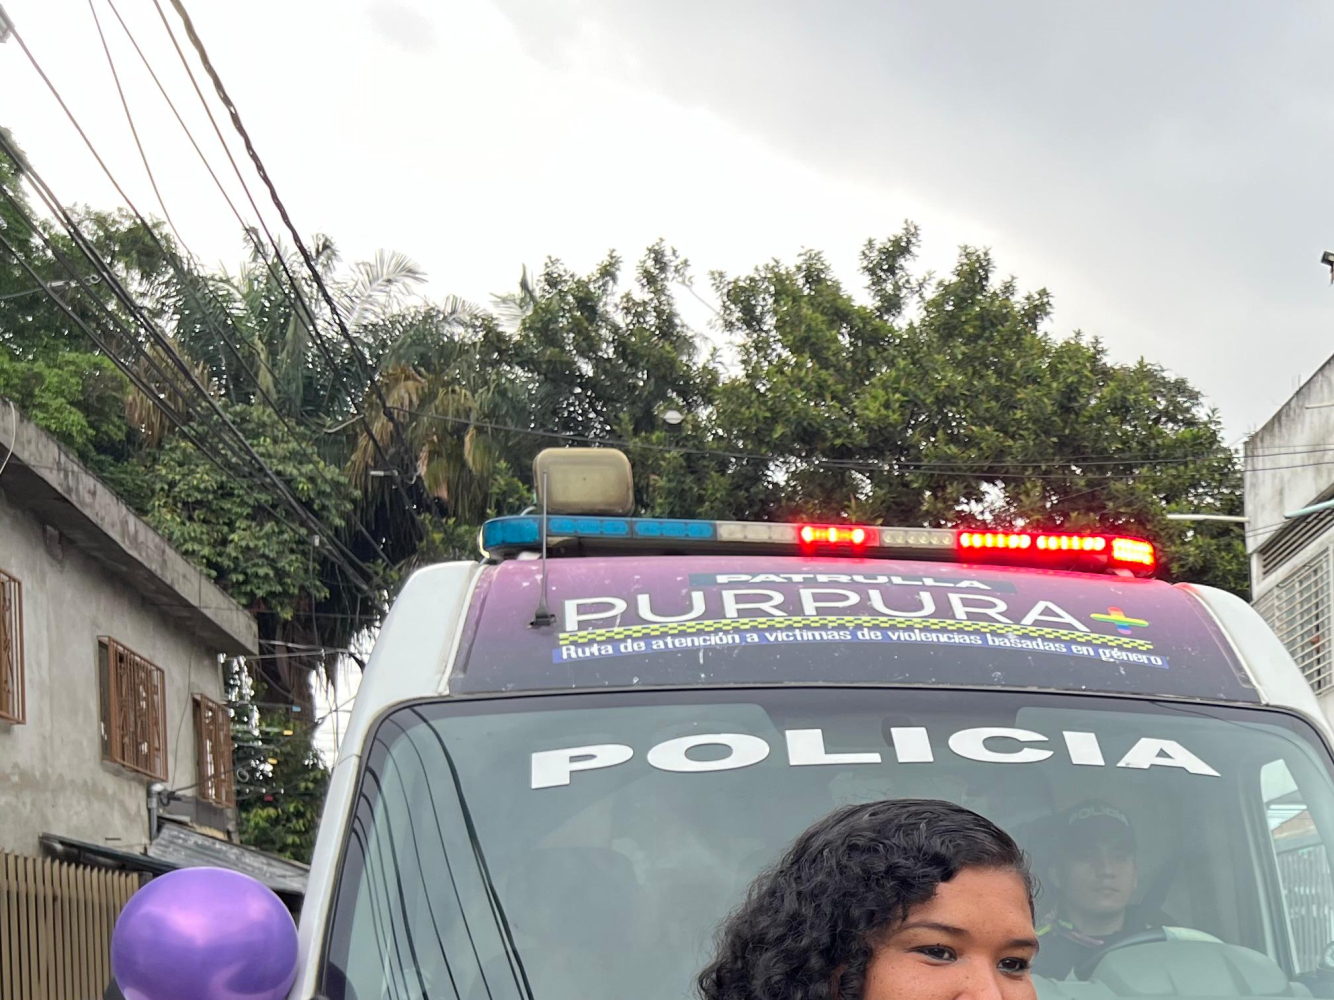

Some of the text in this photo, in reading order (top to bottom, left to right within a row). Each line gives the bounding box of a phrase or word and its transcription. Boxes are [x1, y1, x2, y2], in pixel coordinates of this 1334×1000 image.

[716, 573, 992, 590] PATRULLA
[561, 643, 614, 660] Ruta
[619, 638, 646, 653] de
[651, 631, 741, 650] atención
[746, 633, 759, 644] a
[857, 628, 883, 641] de
[887, 628, 983, 646] violencias
[987, 633, 1067, 654] basadas
[1071, 645, 1095, 657] en
[1099, 648, 1163, 666] género
[530, 726, 1222, 790] POLICIA
